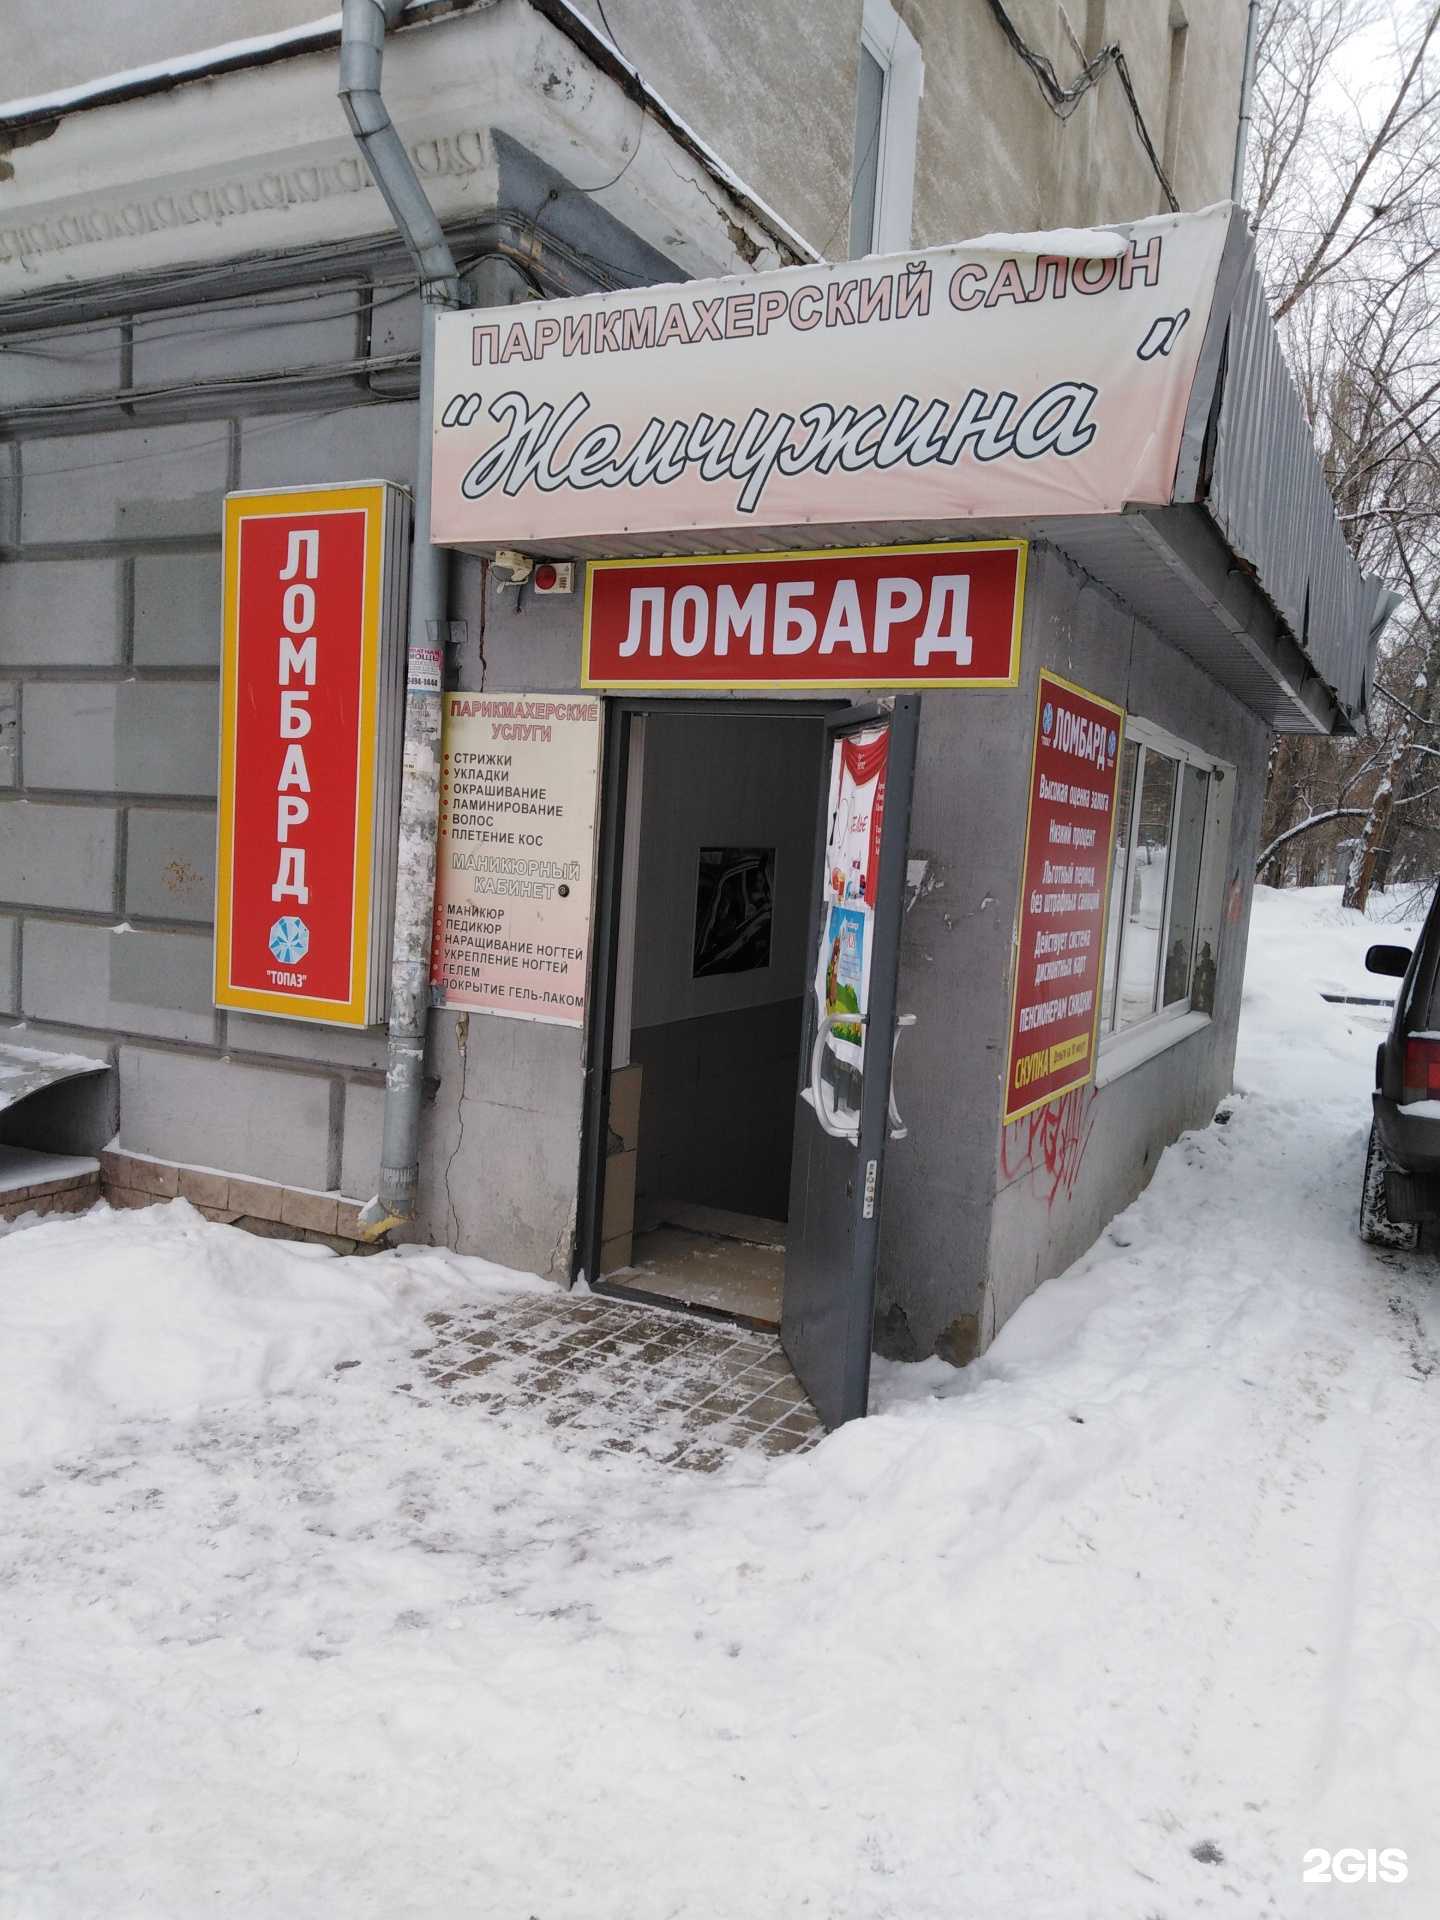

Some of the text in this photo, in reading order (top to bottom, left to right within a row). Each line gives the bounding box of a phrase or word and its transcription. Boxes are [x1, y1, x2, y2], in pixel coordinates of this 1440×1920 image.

[472, 236, 1162, 366] ПАРИКМАХЕРСКИЙ САЛОН
[619, 575, 973, 666] ЛОМБАРД
[272, 529, 320, 905] ЛОМБАРД
[450, 700, 598, 722] ПАРИКМАХЕРСКИЕ
[491, 723, 552, 742] УСЛУГИ
[1053, 707, 1107, 771] ЛОМБАРД
[454, 752, 512, 767] СТРИЖКИ
[454, 767, 509, 782] УКЛАДКИ
[453, 783, 547, 800] ОКРАШИВАНИЕ
[1039, 773, 1109, 812] Высокая оценка залога
[452, 798, 563, 817] ЛАМИНИРОВАНИЕ
[452, 813, 494, 827] ВОЛОС
[451, 828, 544, 846] ПЛЕТЕНИЕ КОС
[452, 852, 581, 881] МАНИКЮРНЫЙ
[1042, 860, 1074, 885] Льготный
[474, 876, 555, 900] КАБИНЕТ
[447, 904, 505, 920] МАНИКЮР
[1030, 889, 1042, 914] без
[446, 919, 502, 935] ПЕДИКЮР
[445, 933, 584, 961] НАРАЩИВАНИЕ НОГТЕЙ
[1034, 931, 1068, 959] Действует
[443, 963, 480, 977] ГЕЛЕМ
[444, 948, 568, 975] УКРЕПЛЕНИЕ НОГТЕЙ
[266, 969, 308, 988] "ТОПАЗ"
[443, 978, 584, 1008] ПОКРЫТИЕ ГЕЛЬ-ЛАКОМ
[1019, 997, 1068, 1032] ПЕНСИОНЕРАМ
[1015, 1048, 1048, 1089] СКУПКА
